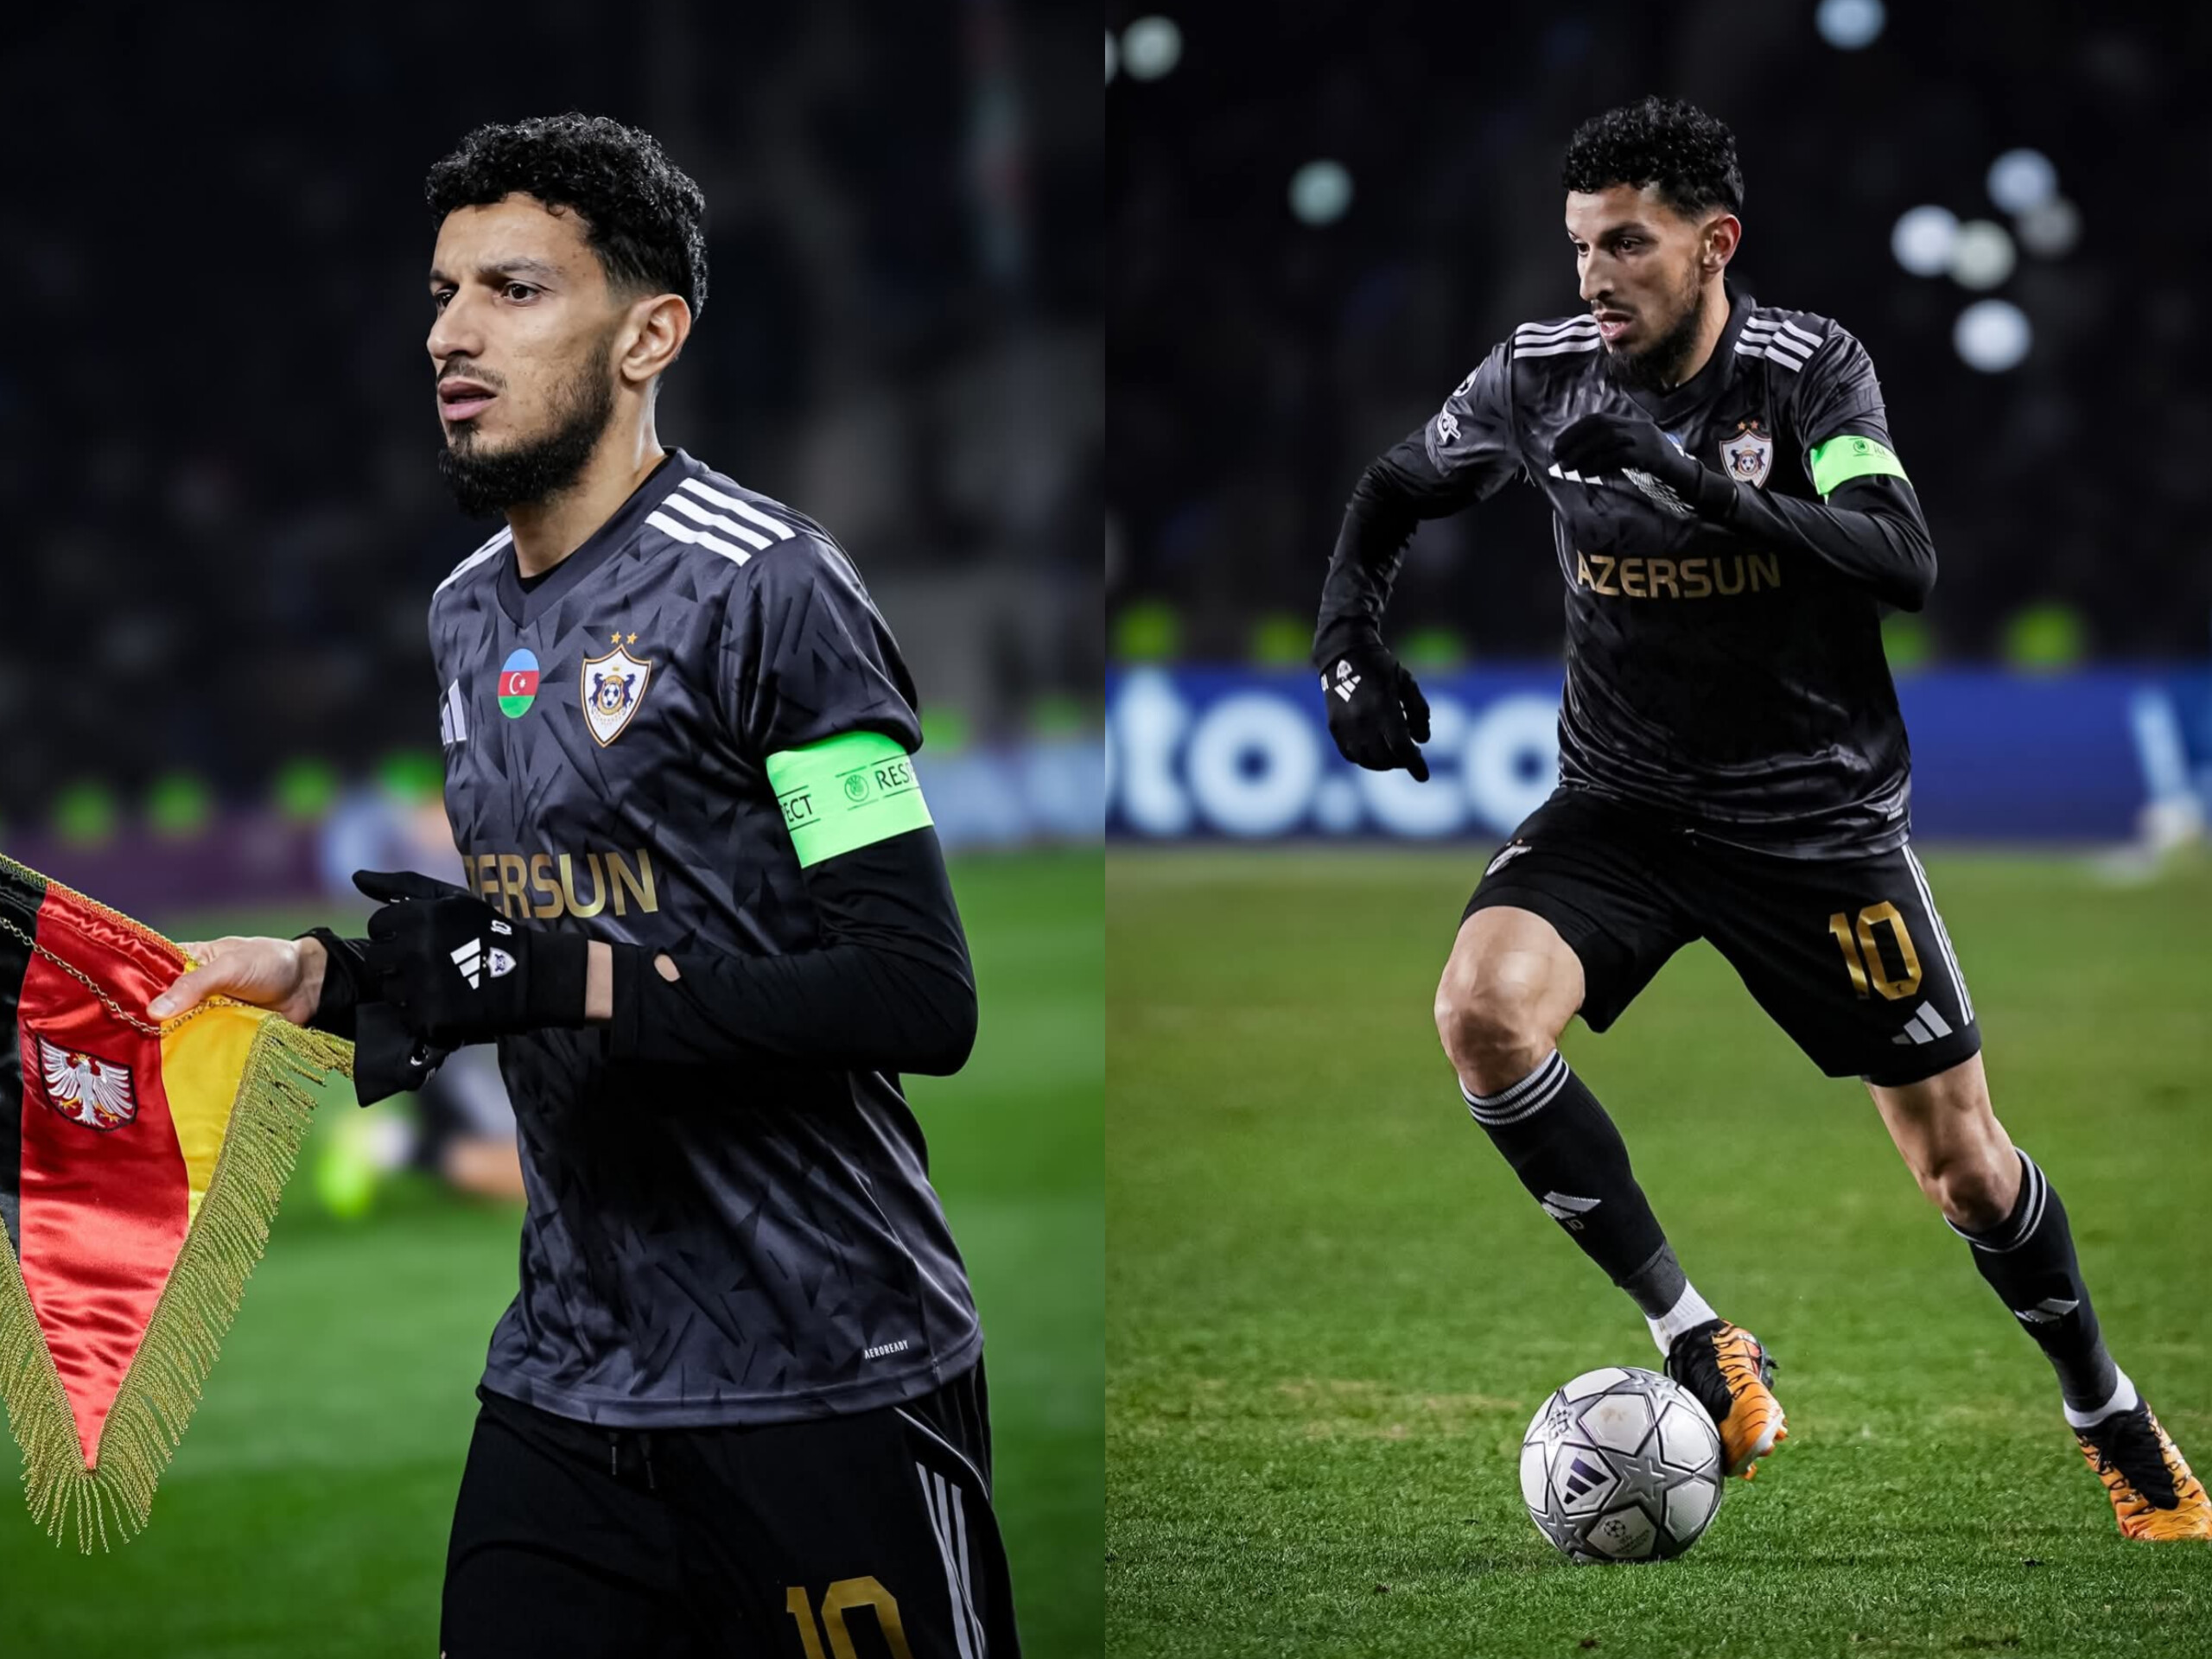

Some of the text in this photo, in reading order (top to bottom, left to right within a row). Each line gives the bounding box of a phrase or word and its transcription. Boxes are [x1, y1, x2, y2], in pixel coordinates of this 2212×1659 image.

[1577, 550, 1782, 599] AZERSUN
[779, 793, 813, 823] ECT
[1828, 900, 1923, 1001] 10
[864, 1339, 909, 1360] AEROREADY
